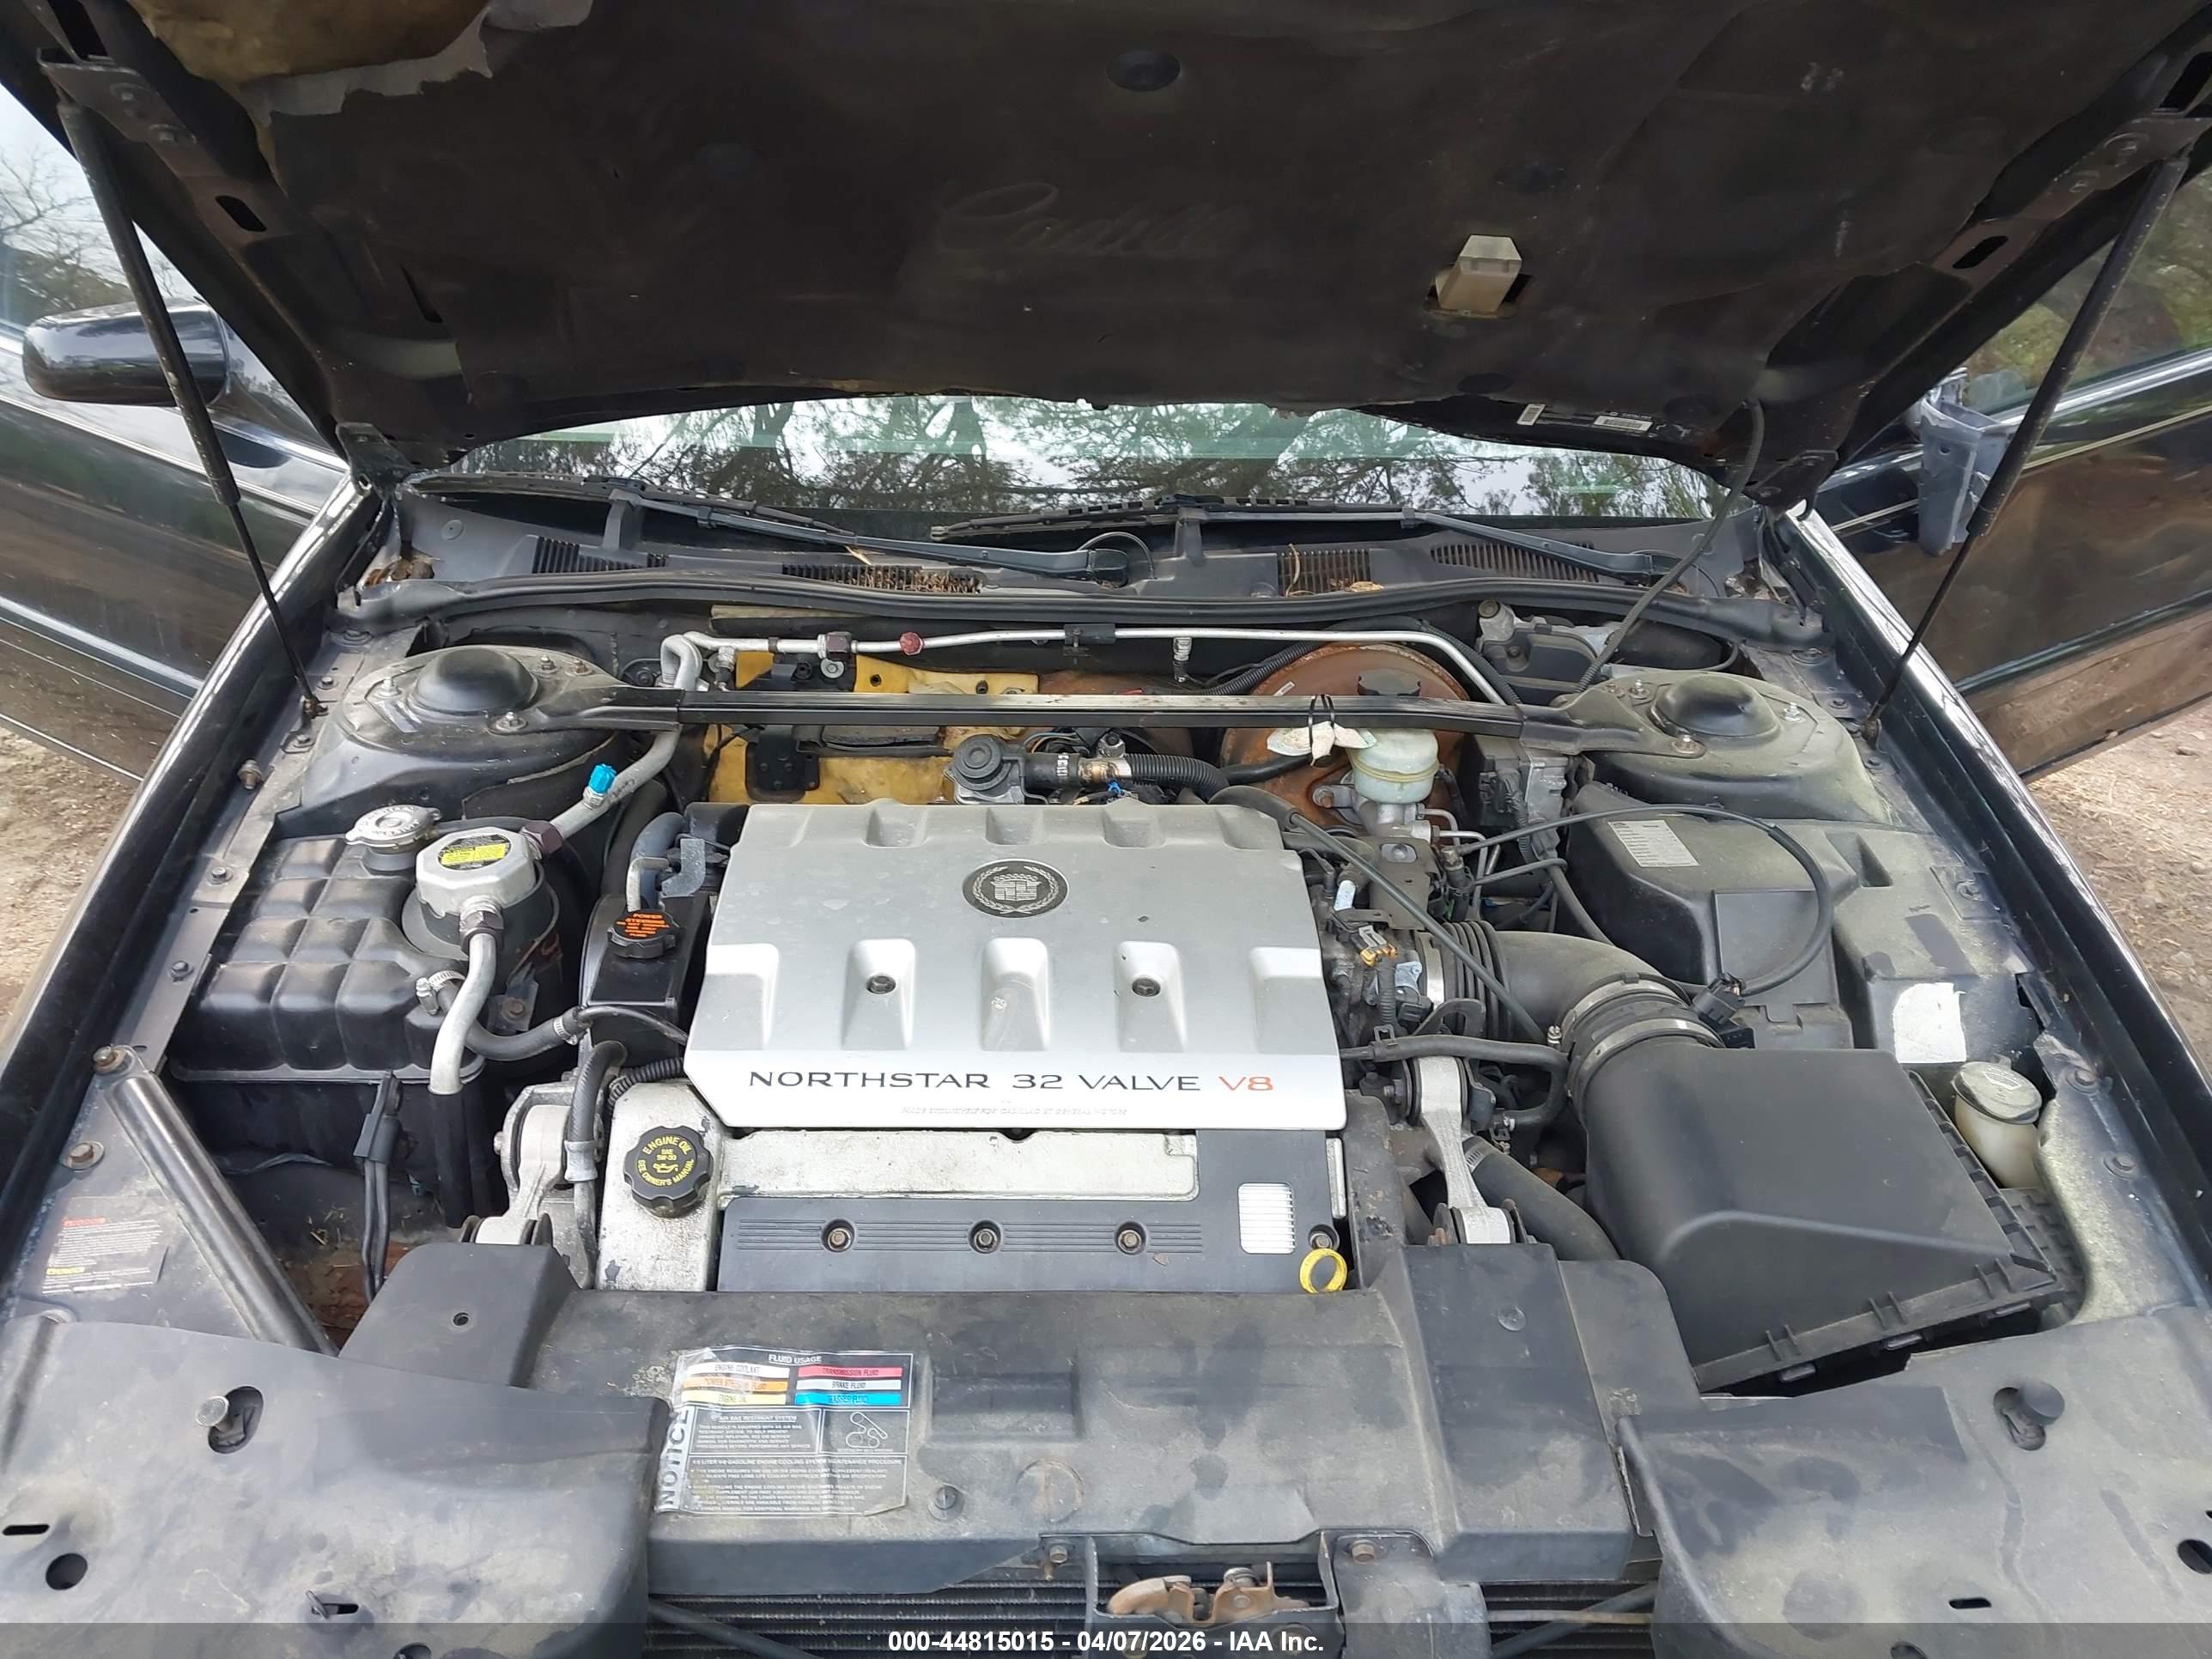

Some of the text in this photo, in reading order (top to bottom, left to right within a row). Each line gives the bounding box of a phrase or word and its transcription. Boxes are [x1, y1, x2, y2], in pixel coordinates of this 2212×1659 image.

[749, 1070, 1274, 1092] NORTHSTAR 32 VALVE V8
[642, 1136, 692, 1155] ENGINE OIL
[672, 1159, 695, 1183] MANUAL
[769, 1354, 823, 1363] FLUID USAGE
[860, 1368, 879, 1376] FLUID
[831, 1380, 866, 1389] BRAKE FLUID
